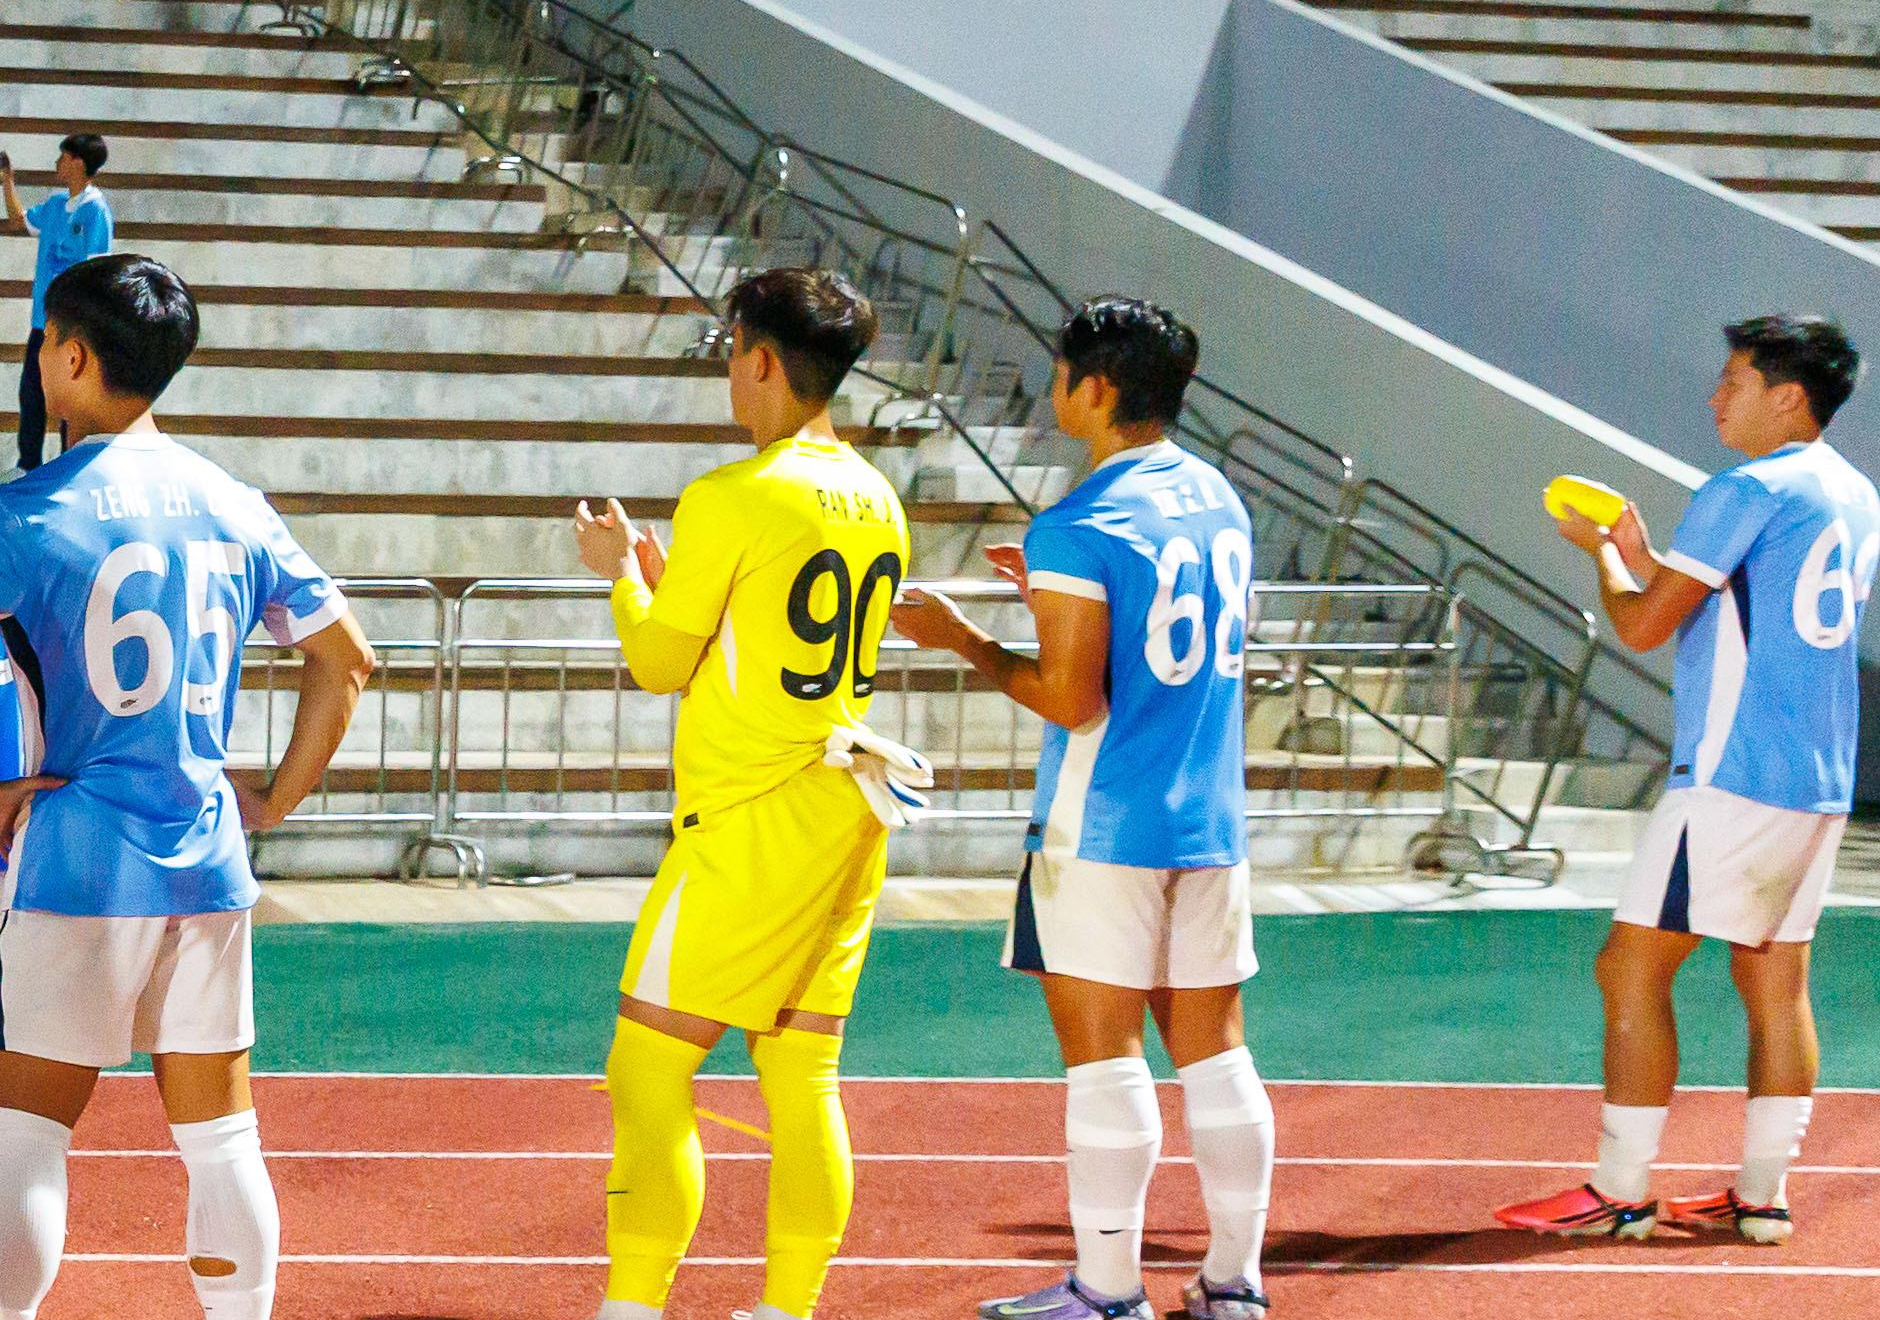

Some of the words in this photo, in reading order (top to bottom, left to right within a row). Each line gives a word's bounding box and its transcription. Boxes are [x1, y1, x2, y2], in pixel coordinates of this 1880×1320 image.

[84, 539, 246, 717] 65
[780, 548, 902, 700] 90
[1145, 528, 1253, 686] 68
